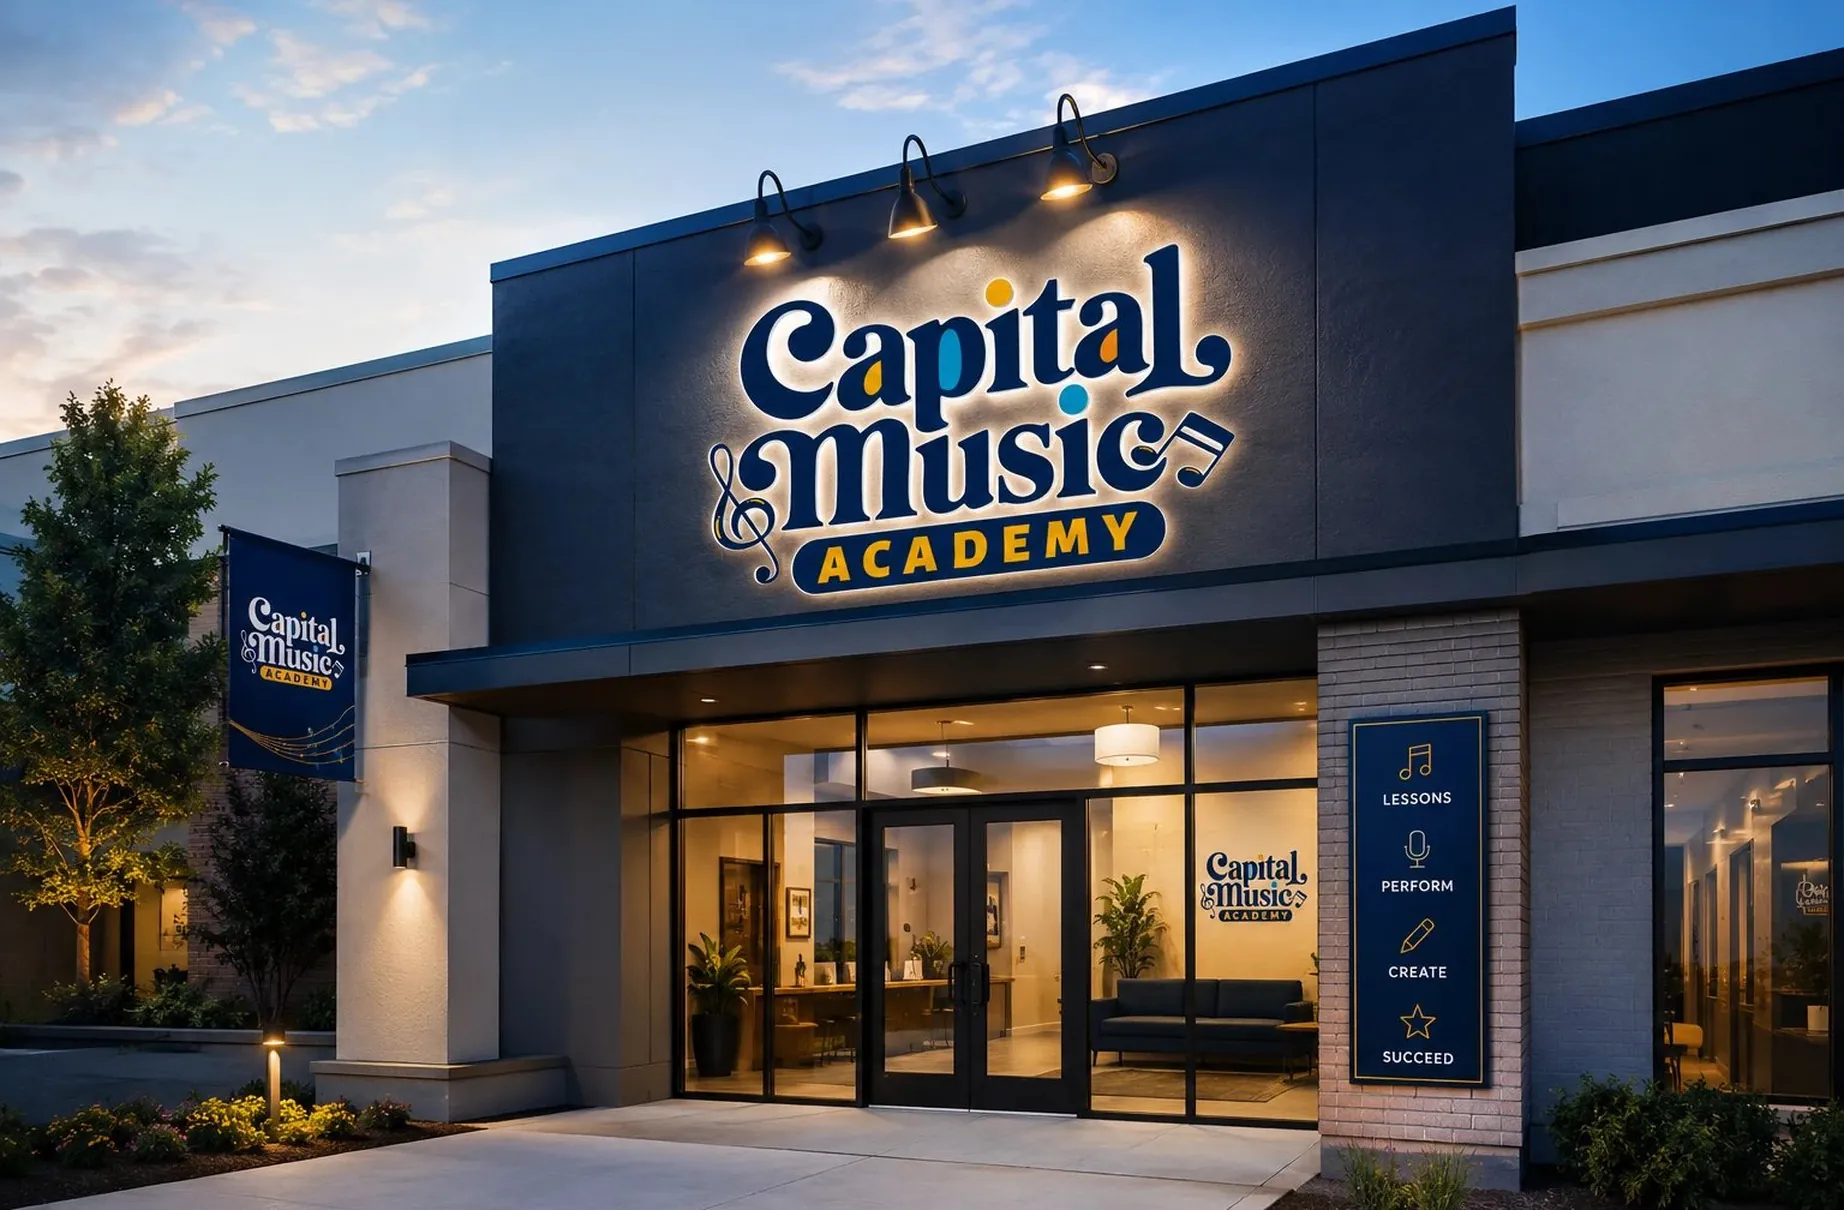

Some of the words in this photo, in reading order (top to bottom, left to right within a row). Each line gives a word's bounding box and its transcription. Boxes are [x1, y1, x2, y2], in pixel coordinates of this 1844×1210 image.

[740, 244, 1232, 433] Capital
[738, 384, 1168, 531] Music
[817, 511, 1138, 584] ACADEMY
[248, 596, 345, 655] Capital
[248, 631, 333, 676] Music
[265, 669, 329, 689] ACADEMY
[1382, 791, 1452, 806] LESSONS
[1206, 850, 1308, 888] Capital
[1207, 881, 1292, 908] Music
[1381, 879, 1454, 893] PERFORM
[1223, 911, 1288, 920] ACADEMY
[1388, 965, 1448, 979] CREATE
[1382, 1050, 1454, 1065] SUCCEED
